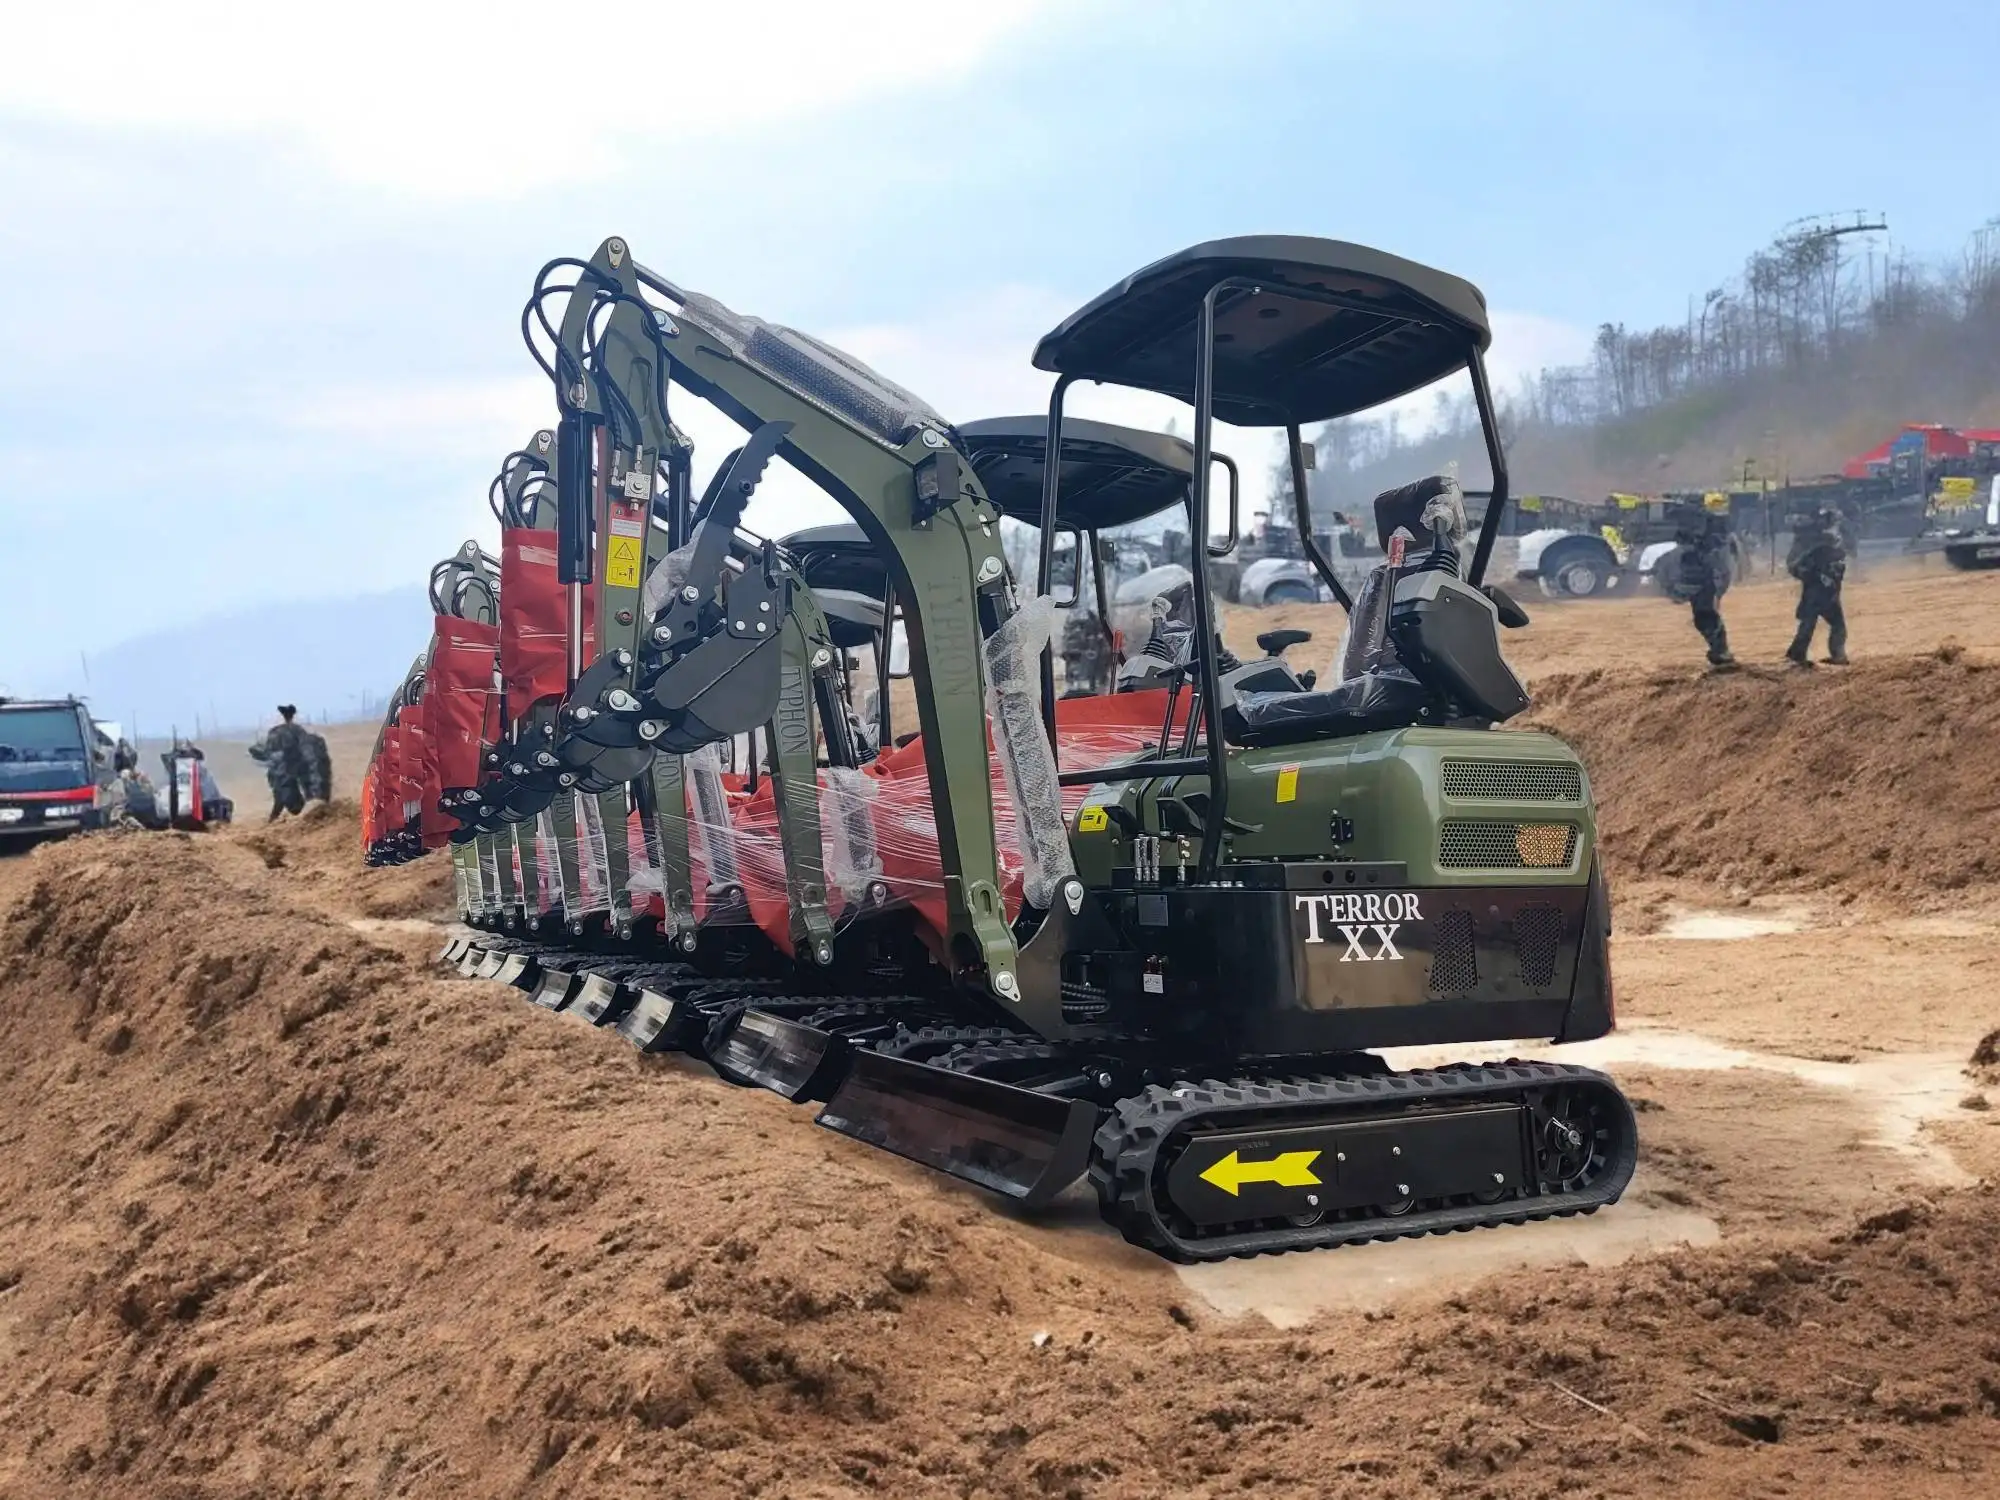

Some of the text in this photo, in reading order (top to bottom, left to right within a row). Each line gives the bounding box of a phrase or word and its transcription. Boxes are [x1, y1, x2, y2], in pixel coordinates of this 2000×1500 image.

[927, 576, 976, 697] TYPHON
[779, 667, 810, 754] TYPHON
[1295, 893, 1424, 943] TERROR
[1337, 924, 1404, 961] XX
